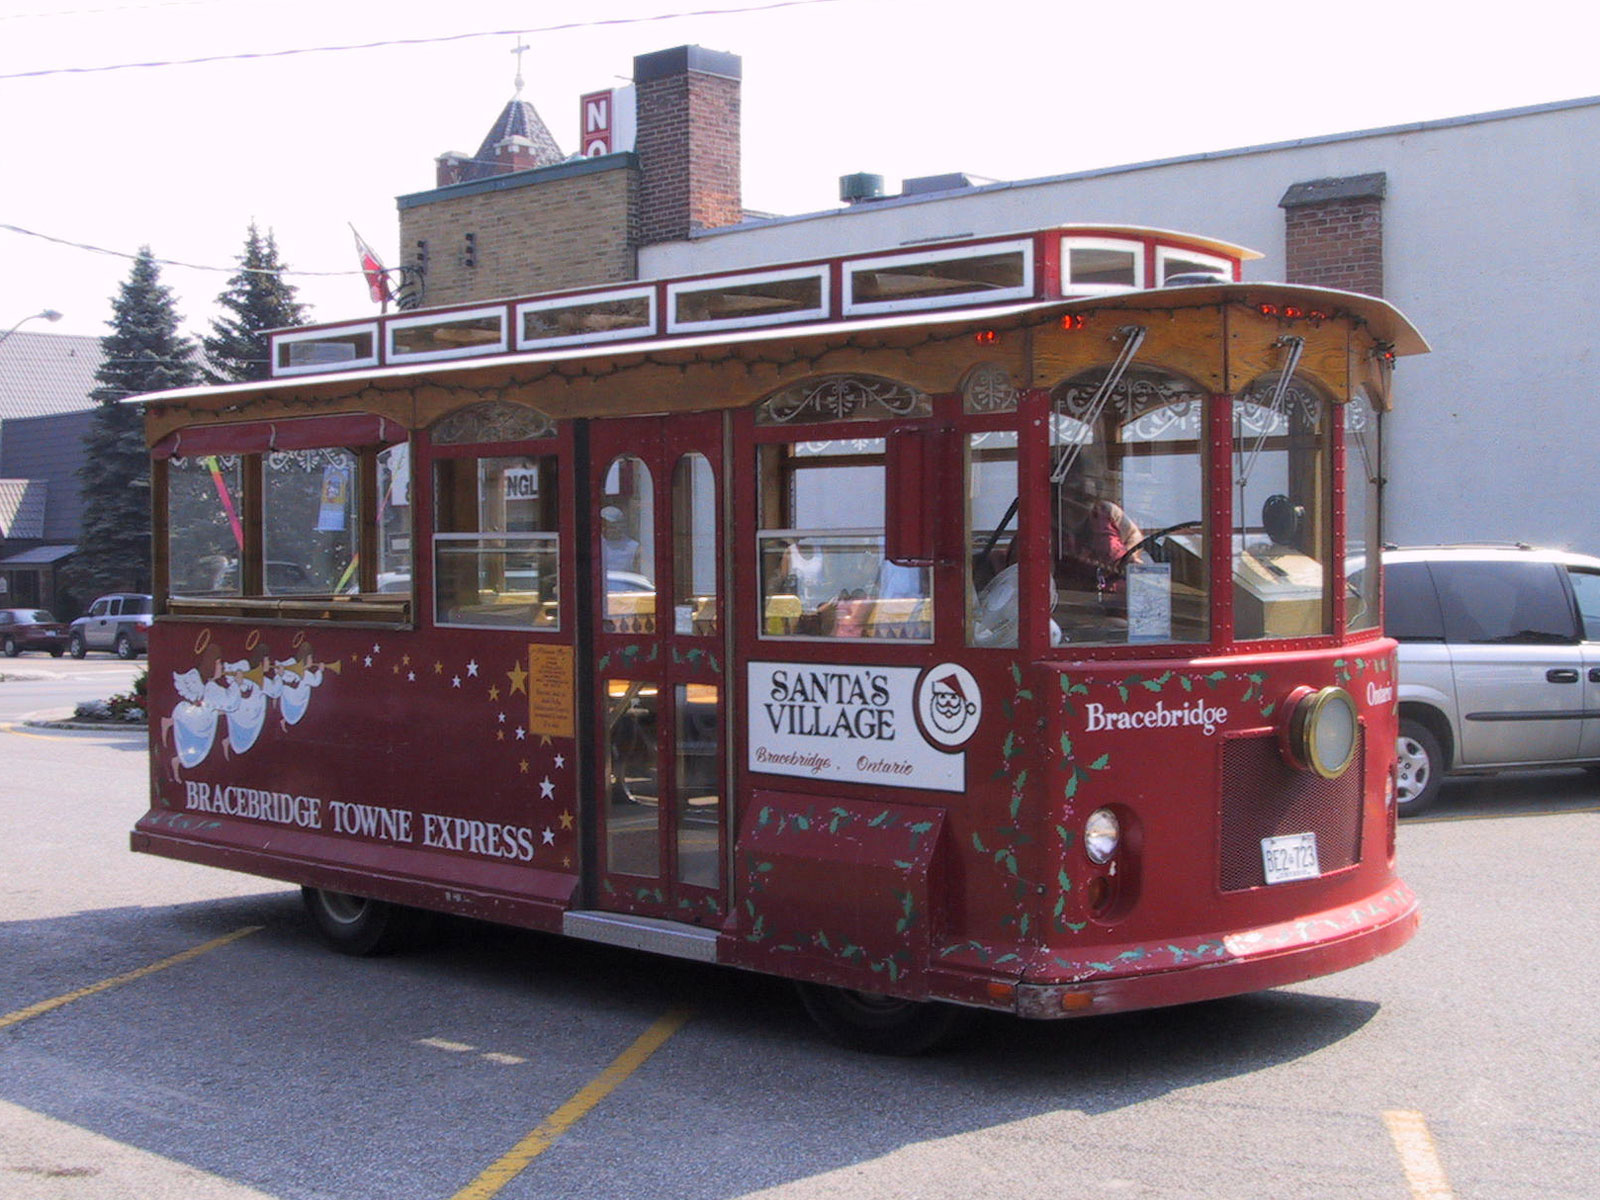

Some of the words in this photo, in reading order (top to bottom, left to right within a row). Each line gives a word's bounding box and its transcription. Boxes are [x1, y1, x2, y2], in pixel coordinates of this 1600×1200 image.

[771, 671, 889, 705] SANTA'S
[765, 705, 895, 741] VILLAGE
[1085, 699, 1228, 736] Bracebridge
[857, 756, 914, 775] Ontario
[185, 781, 321, 828] BRACEBRIDGE
[328, 801, 413, 843] TOWNE
[422, 813, 534, 861] EXPRESS
